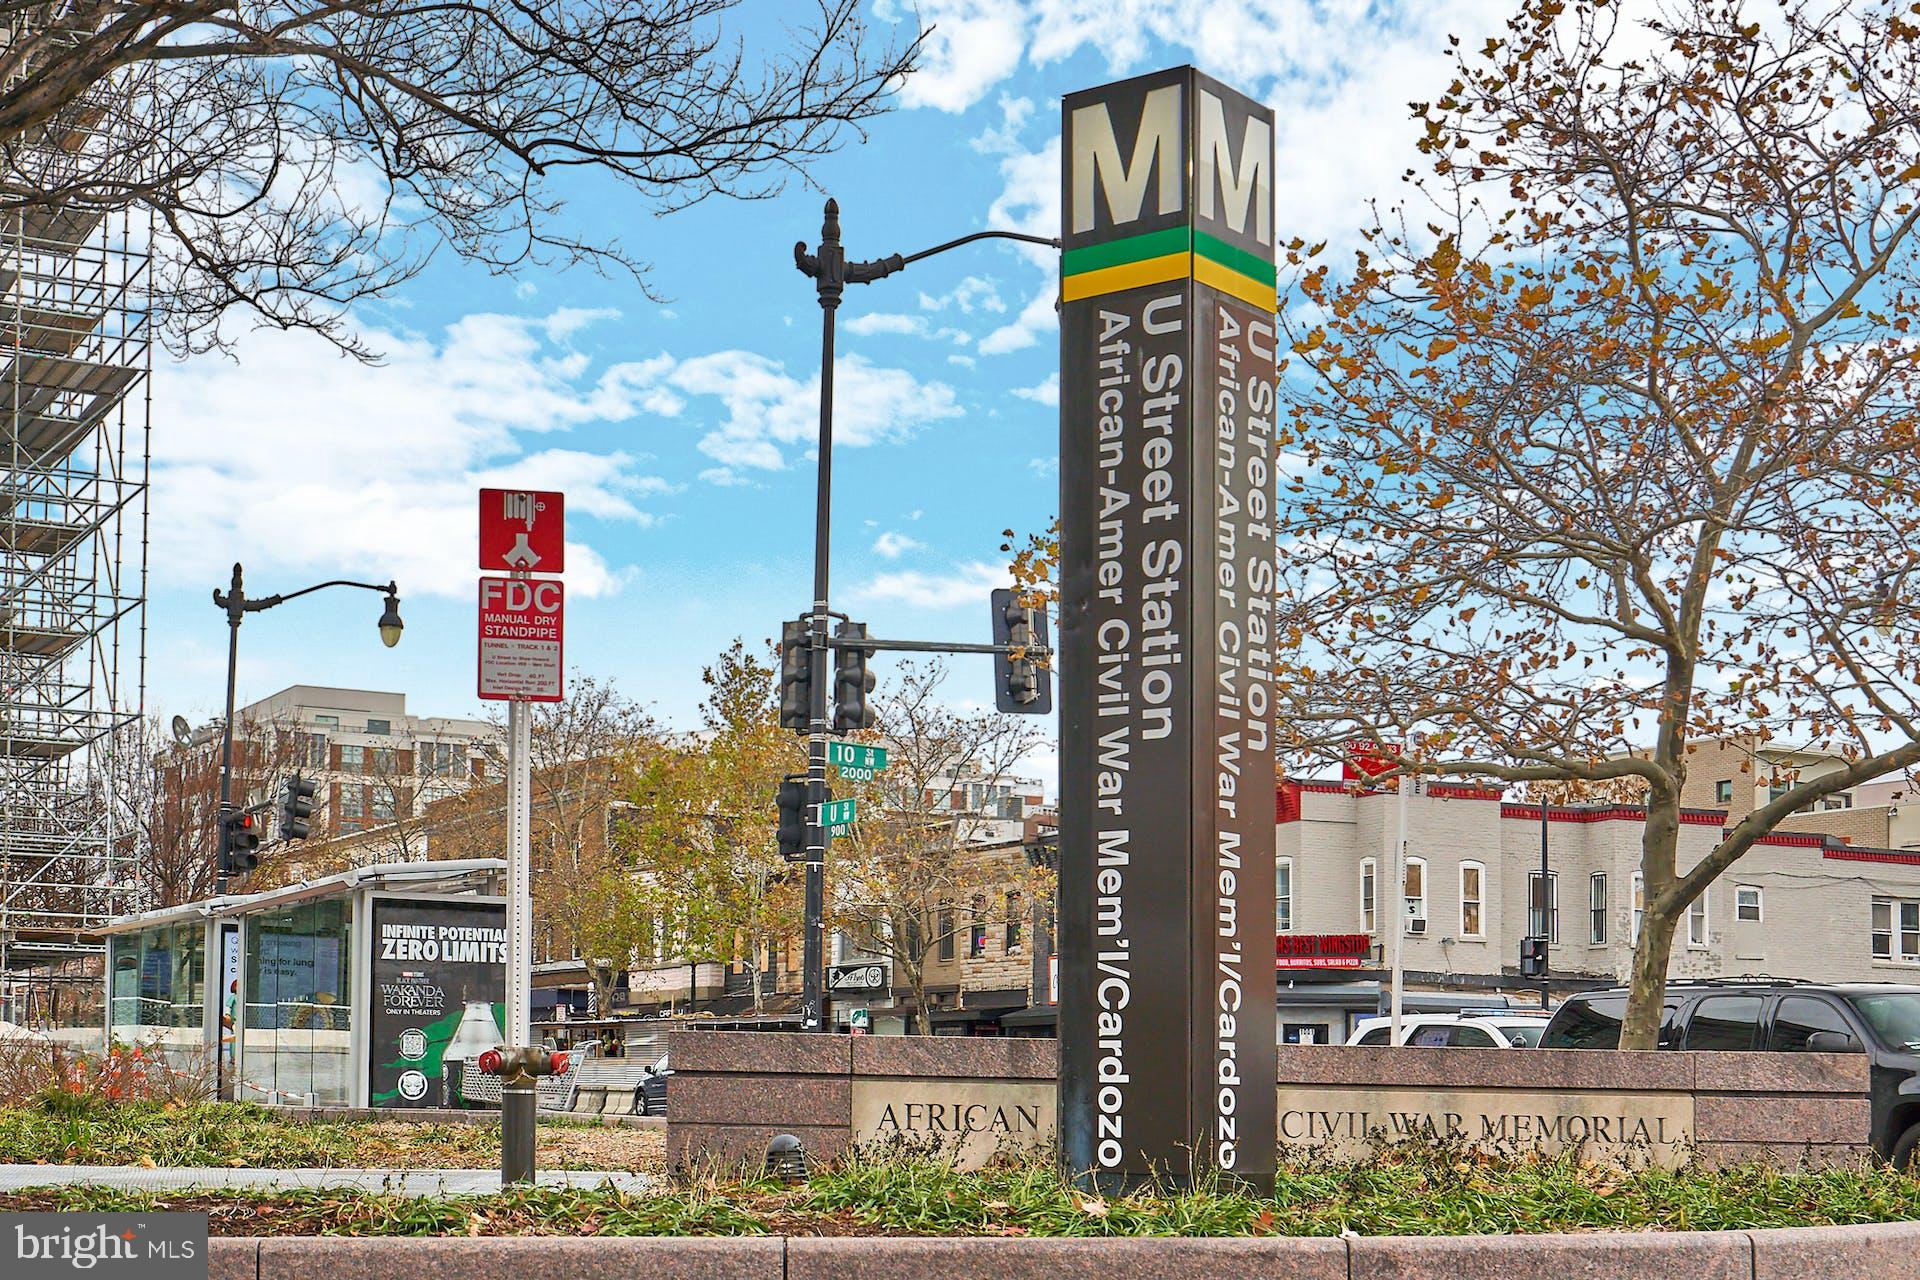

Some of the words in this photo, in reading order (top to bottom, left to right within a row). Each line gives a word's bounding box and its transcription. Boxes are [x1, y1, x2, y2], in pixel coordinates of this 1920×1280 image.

[1072, 84, 1181, 234] M
[1200, 88, 1271, 247] M
[1142, 294, 1182, 336] U
[1247, 320, 1274, 362] U
[1142, 353, 1182, 525] Street
[1098, 309, 1131, 605] African-Amer
[1217, 306, 1241, 608] African-Amer
[1247, 374, 1274, 542] Street
[482, 580, 561, 614] FDC
[484, 613, 531, 625] MANUAL
[534, 616, 558, 626] DRY
[485, 625, 558, 639] STANDPIPE
[1142, 539, 1182, 741] Station
[1247, 556, 1274, 751] Station
[1098, 619, 1131, 717] Civil
[1217, 621, 1241, 720] Civil
[837, 745, 855, 763] 10
[1359, 742, 1371, 752] 92
[841, 767, 872, 780] 2000
[1097, 725, 1131, 817] War
[1217, 731, 1241, 820] War
[830, 804, 837, 822] U
[831, 824, 846, 837] 900
[382, 924, 436, 940] INFINITE
[1292, 936, 1316, 954] BEST
[1319, 935, 1370, 954] WINGSTOP
[279, 958, 291, 966] for
[293, 958, 314, 968] lung
[381, 939, 440, 961] ZERO
[441, 941, 507, 963] LIMITS
[381, 985, 446, 998] WAKANDA
[384, 995, 444, 1008] FOREVER
[386, 1008, 402, 1016] ONLY
[403, 1008, 411, 1016] IN
[411, 1009, 442, 1017] THEATERS
[877, 1103, 1041, 1133] AFRICAN
[1281, 1110, 1371, 1141] CIVIL
[1389, 1111, 1464, 1141] WAR
[1480, 1114, 1678, 1145] MEMORIAL
